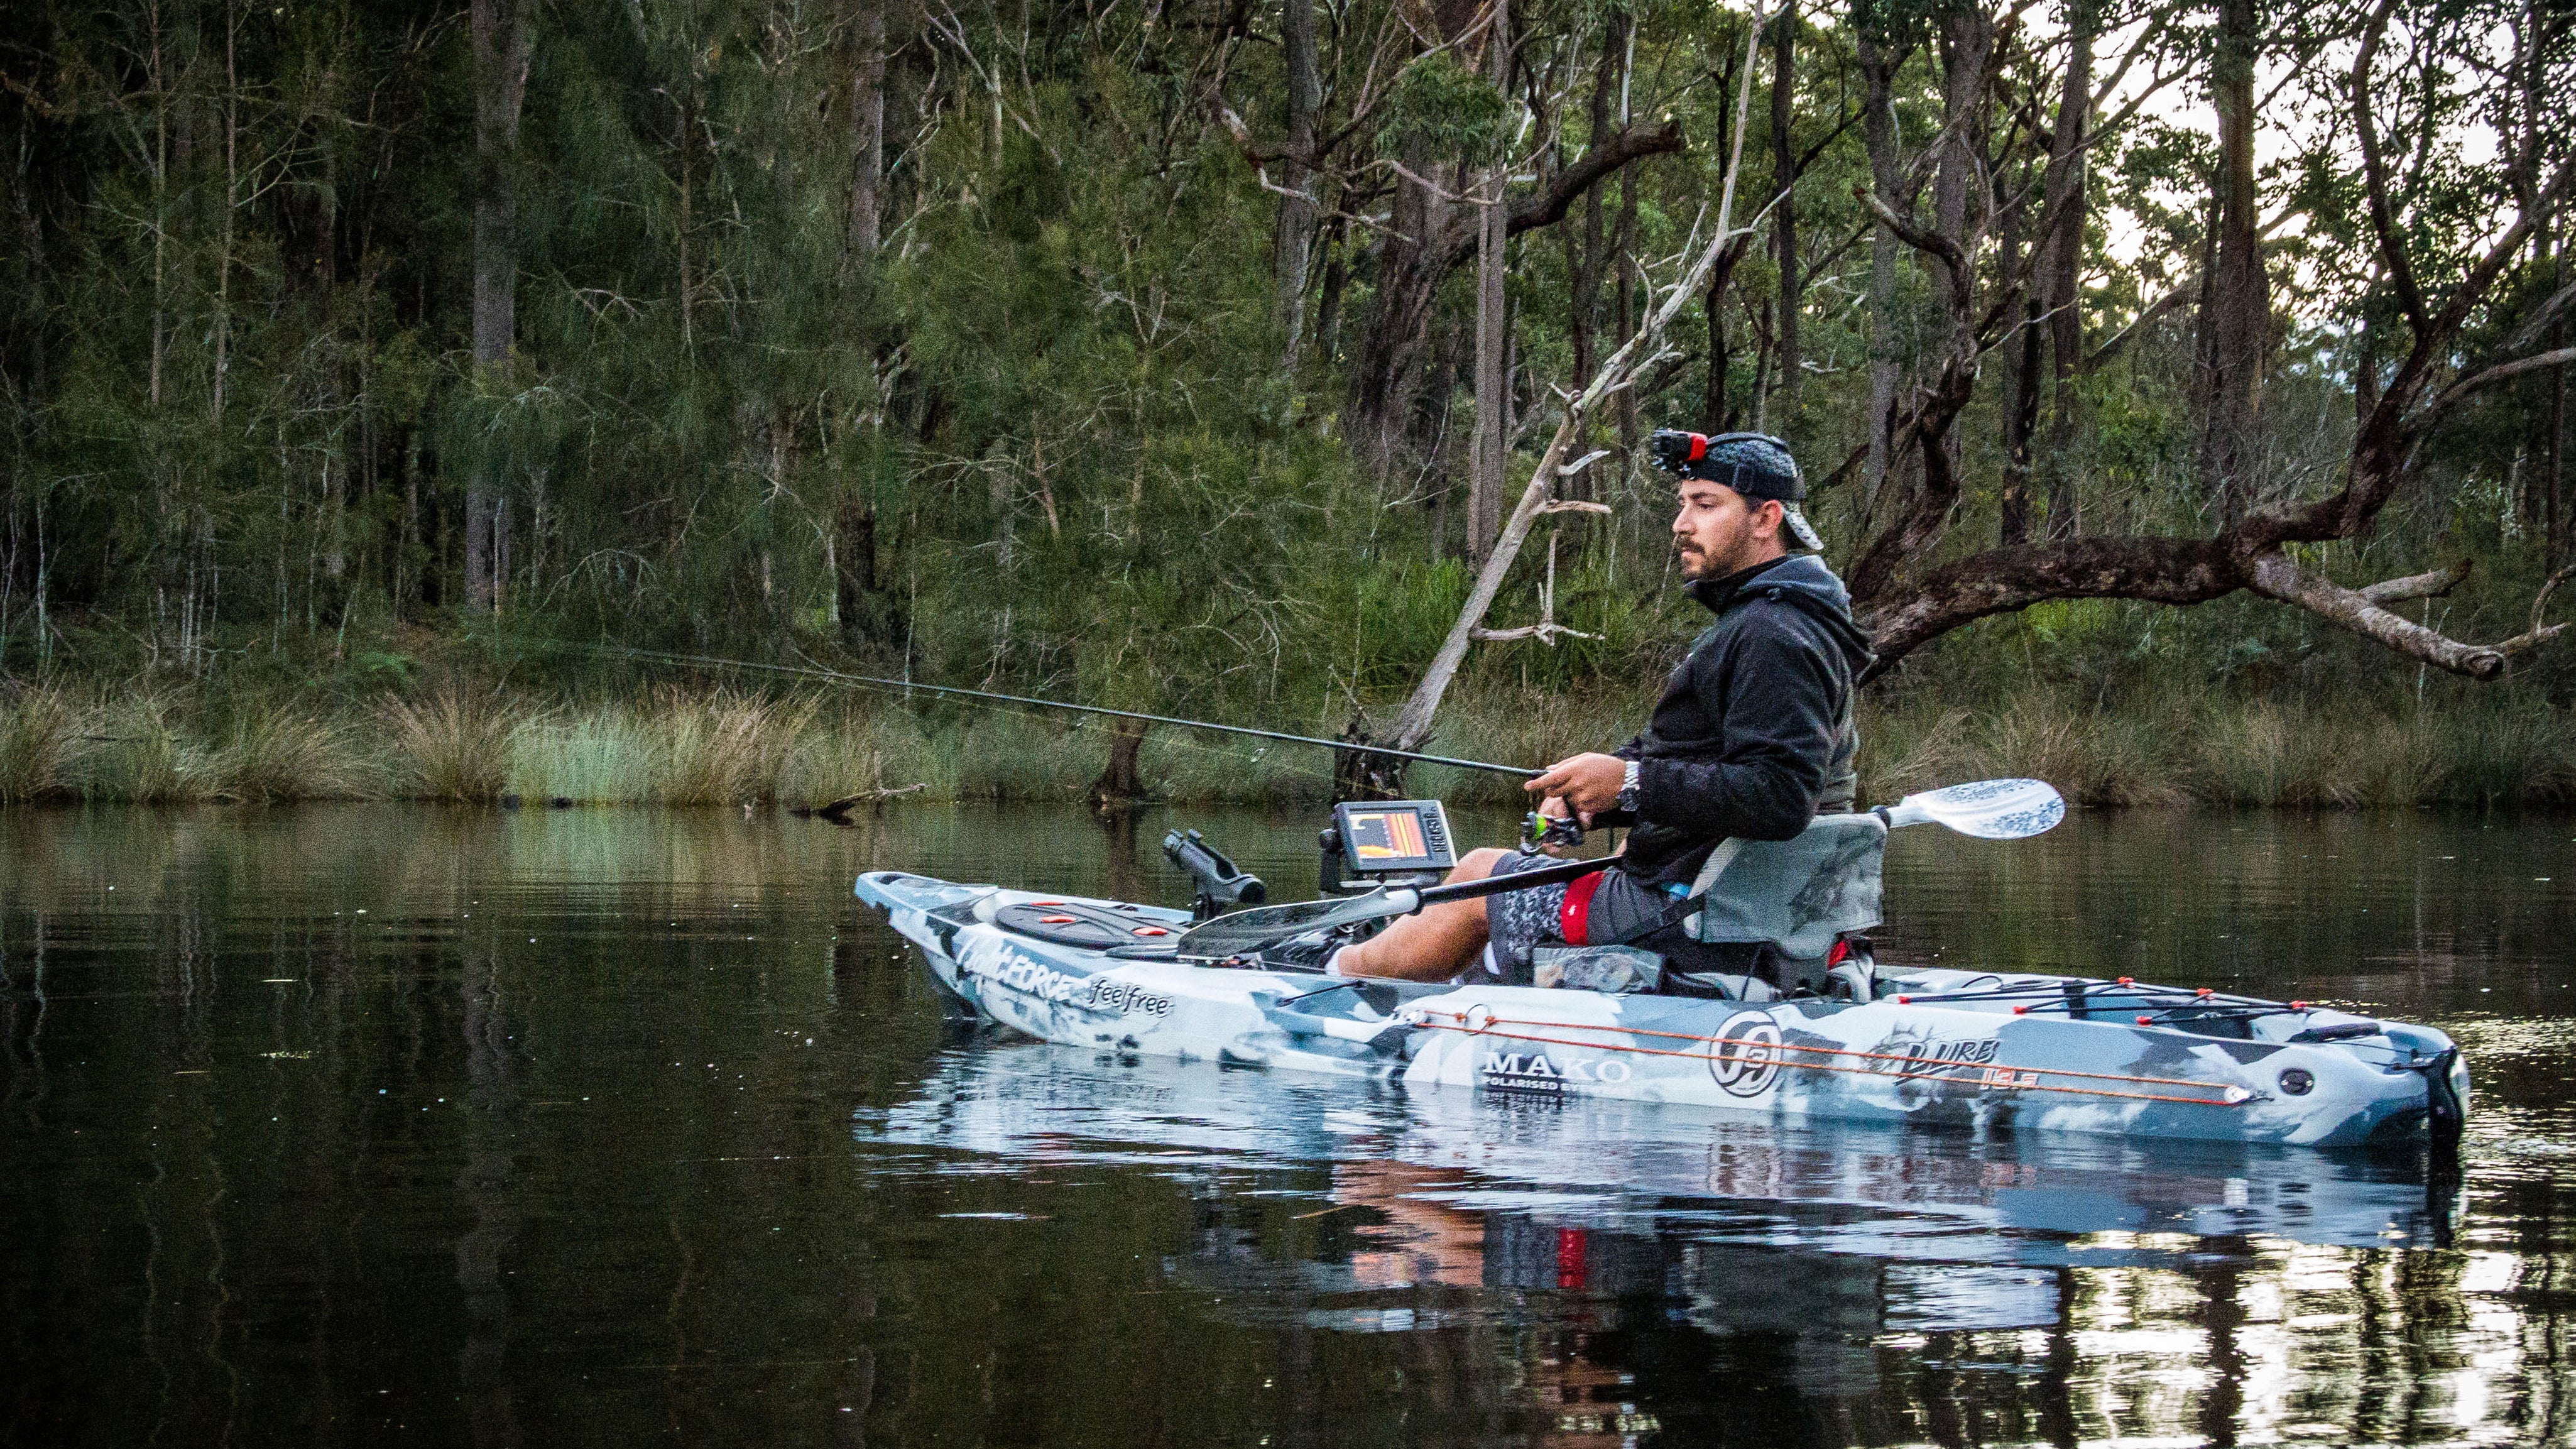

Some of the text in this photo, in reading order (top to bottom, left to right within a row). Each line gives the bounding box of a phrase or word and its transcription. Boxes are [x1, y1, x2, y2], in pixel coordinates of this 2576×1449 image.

[1089, 977, 1171, 1016] feelfree
[1482, 1051, 1632, 1083] MAKO
[1481, 1076, 1559, 1091] POLARISED
